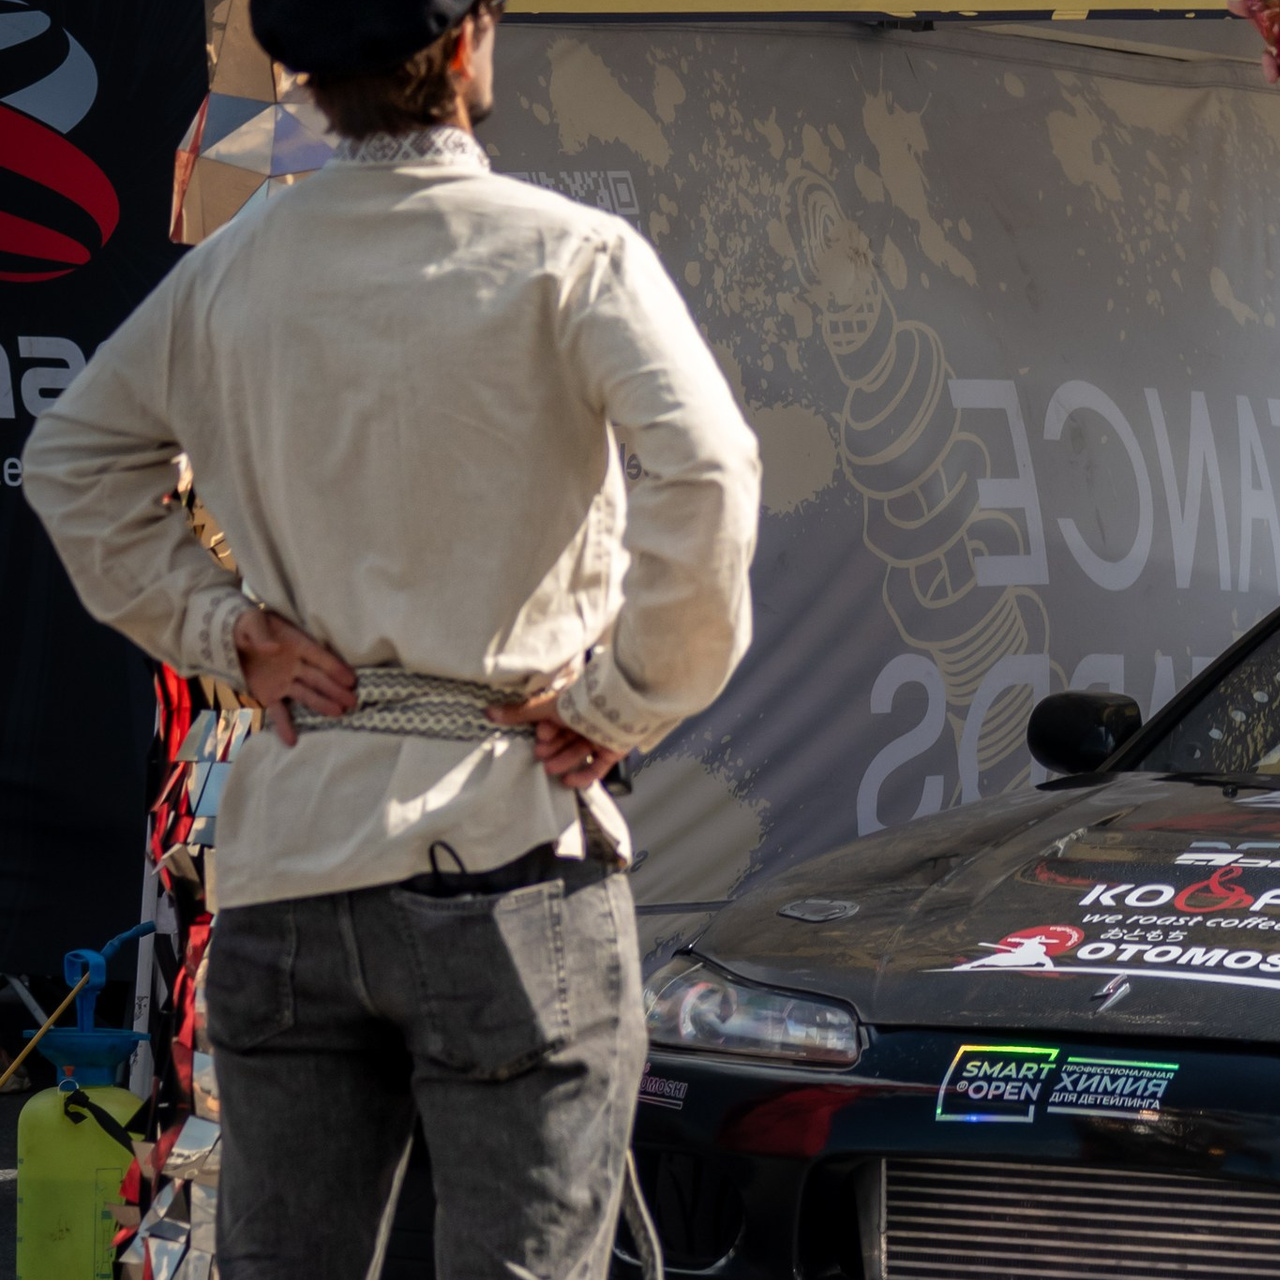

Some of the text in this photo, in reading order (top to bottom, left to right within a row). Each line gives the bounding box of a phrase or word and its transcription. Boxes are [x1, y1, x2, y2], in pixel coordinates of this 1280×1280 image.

[1081, 912, 1117, 924] we
[1125, 914, 1204, 927] roast
[962, 1060, 1057, 1080] SMART
[1061, 1064, 1175, 1080] ПРОФЕССИОНАЛЬНАЯ
[1053, 1073, 1169, 1098] ХИМИЯ
[1049, 1091, 1161, 1111] ДЛЯ ДЕТЕЙЛИНГА
